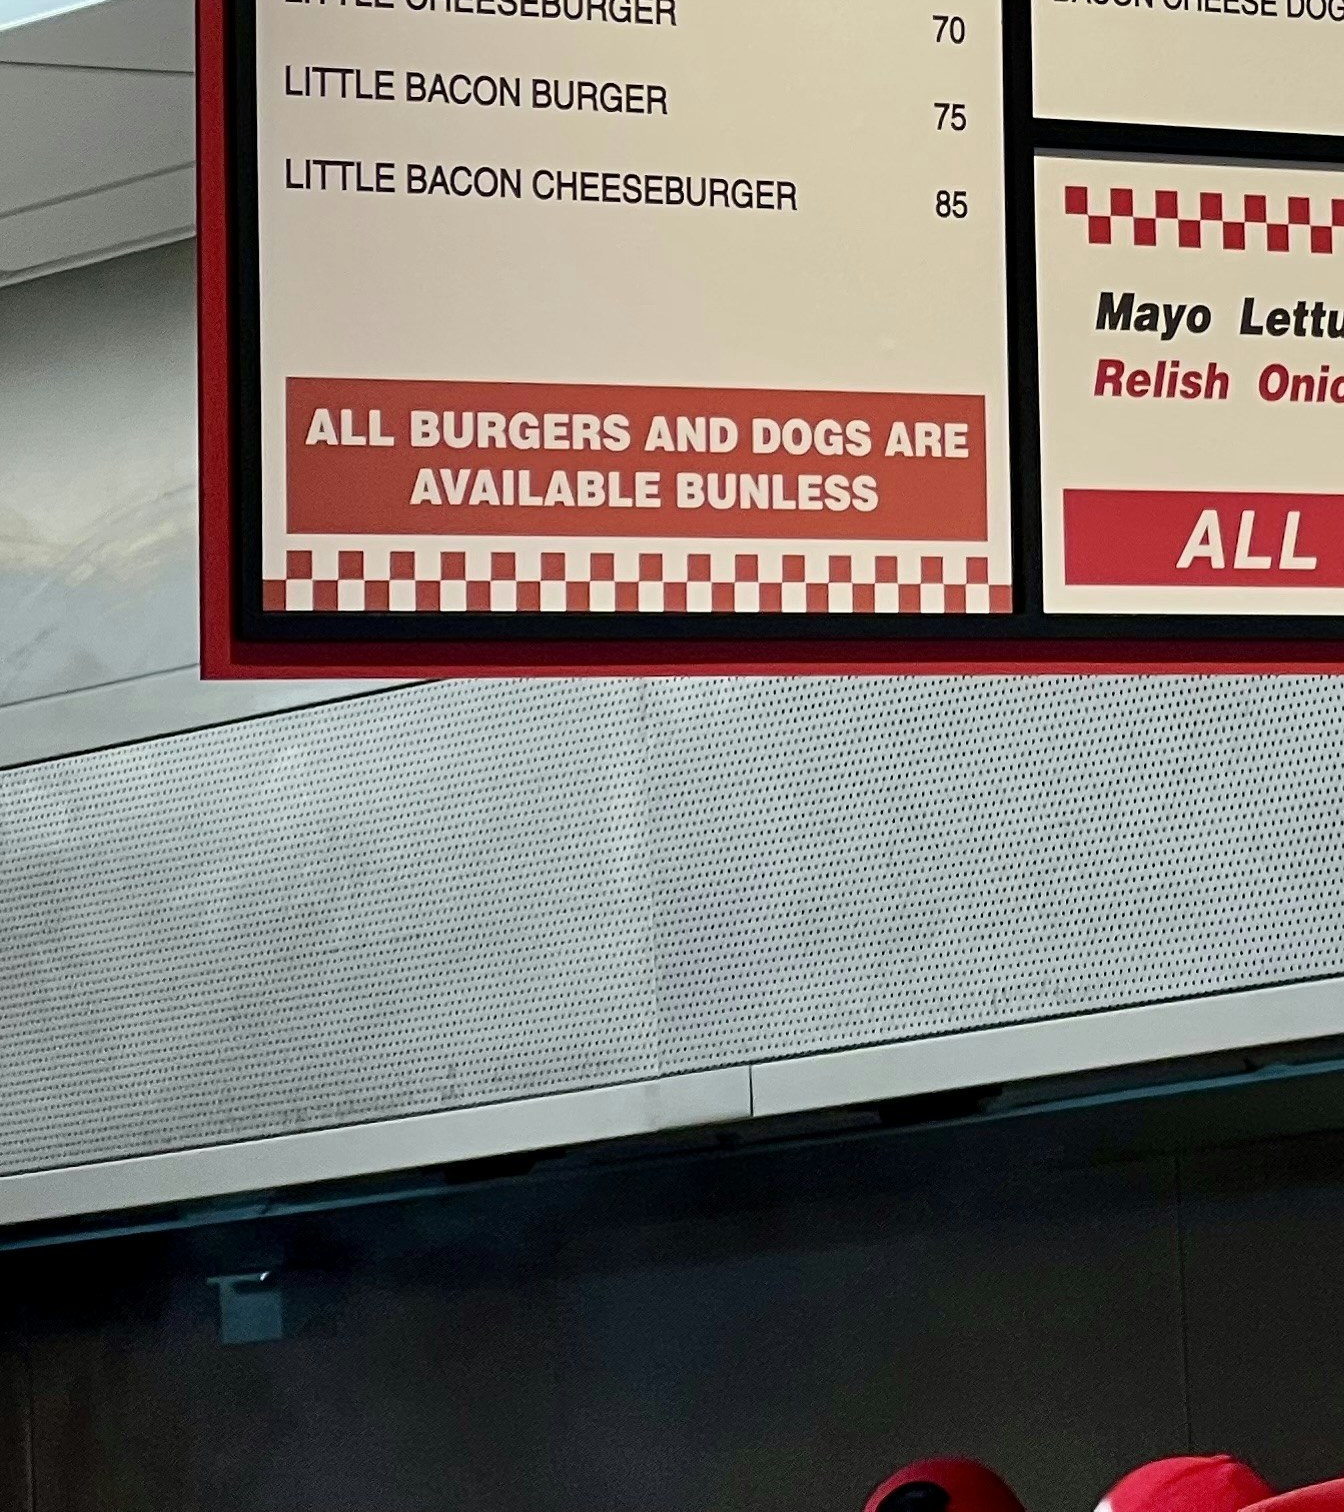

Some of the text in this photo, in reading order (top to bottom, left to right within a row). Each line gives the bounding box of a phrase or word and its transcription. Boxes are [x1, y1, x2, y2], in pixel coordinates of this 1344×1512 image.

[286, 159, 797, 210] LITTLE BACON CHEESEBURGER
[936, 190, 967, 218] 85
[1096, 292, 1211, 340] Mayo
[1094, 359, 1228, 399] Relish
[305, 409, 968, 457] ALL BURGERS AND DOGS ARE
[410, 468, 878, 511] AVAILABLE BUNLESS
